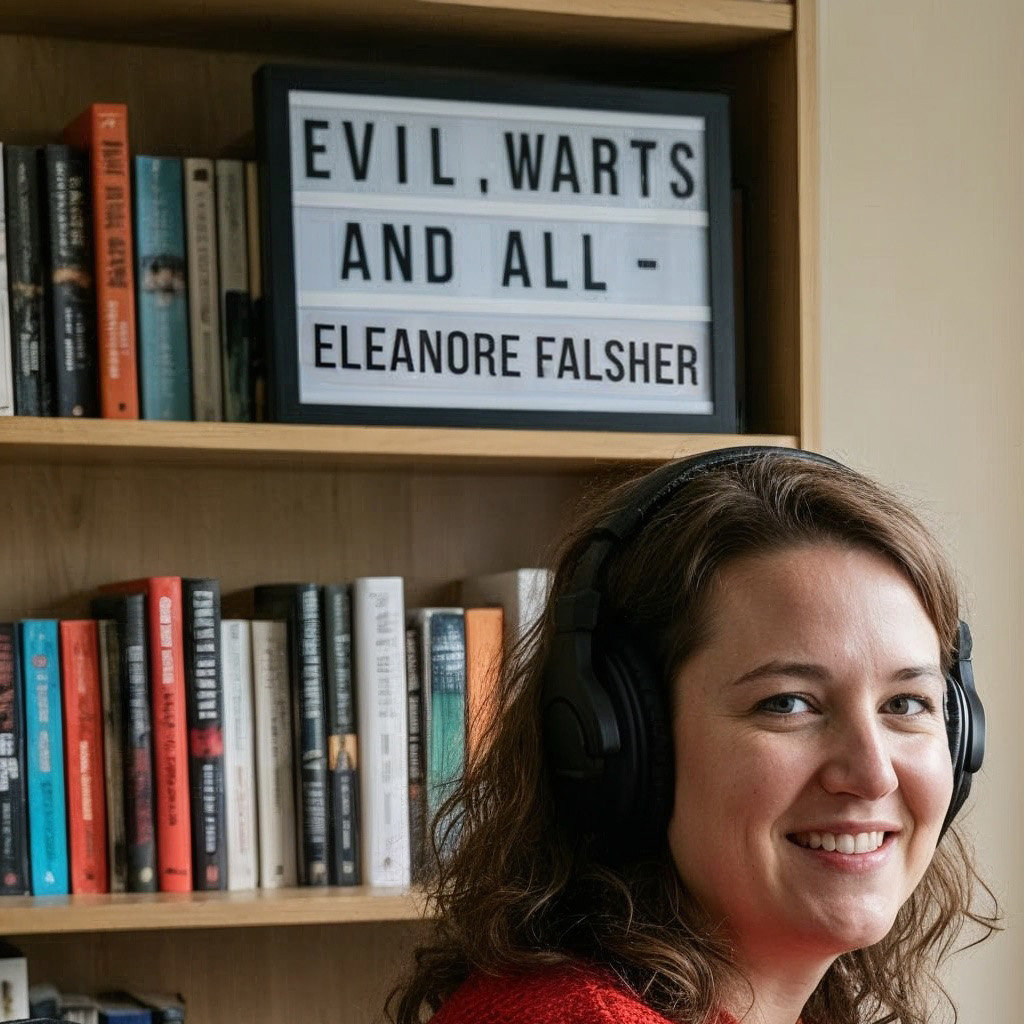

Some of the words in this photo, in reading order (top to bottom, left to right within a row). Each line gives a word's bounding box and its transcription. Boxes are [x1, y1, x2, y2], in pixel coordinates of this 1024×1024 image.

[504, 131, 695, 199] WARTS
[341, 222, 454, 283] AND
[502, 230, 607, 291] ALL
[313, 323, 521, 378] ELEANORE
[535, 336, 699, 387] FALSHER
